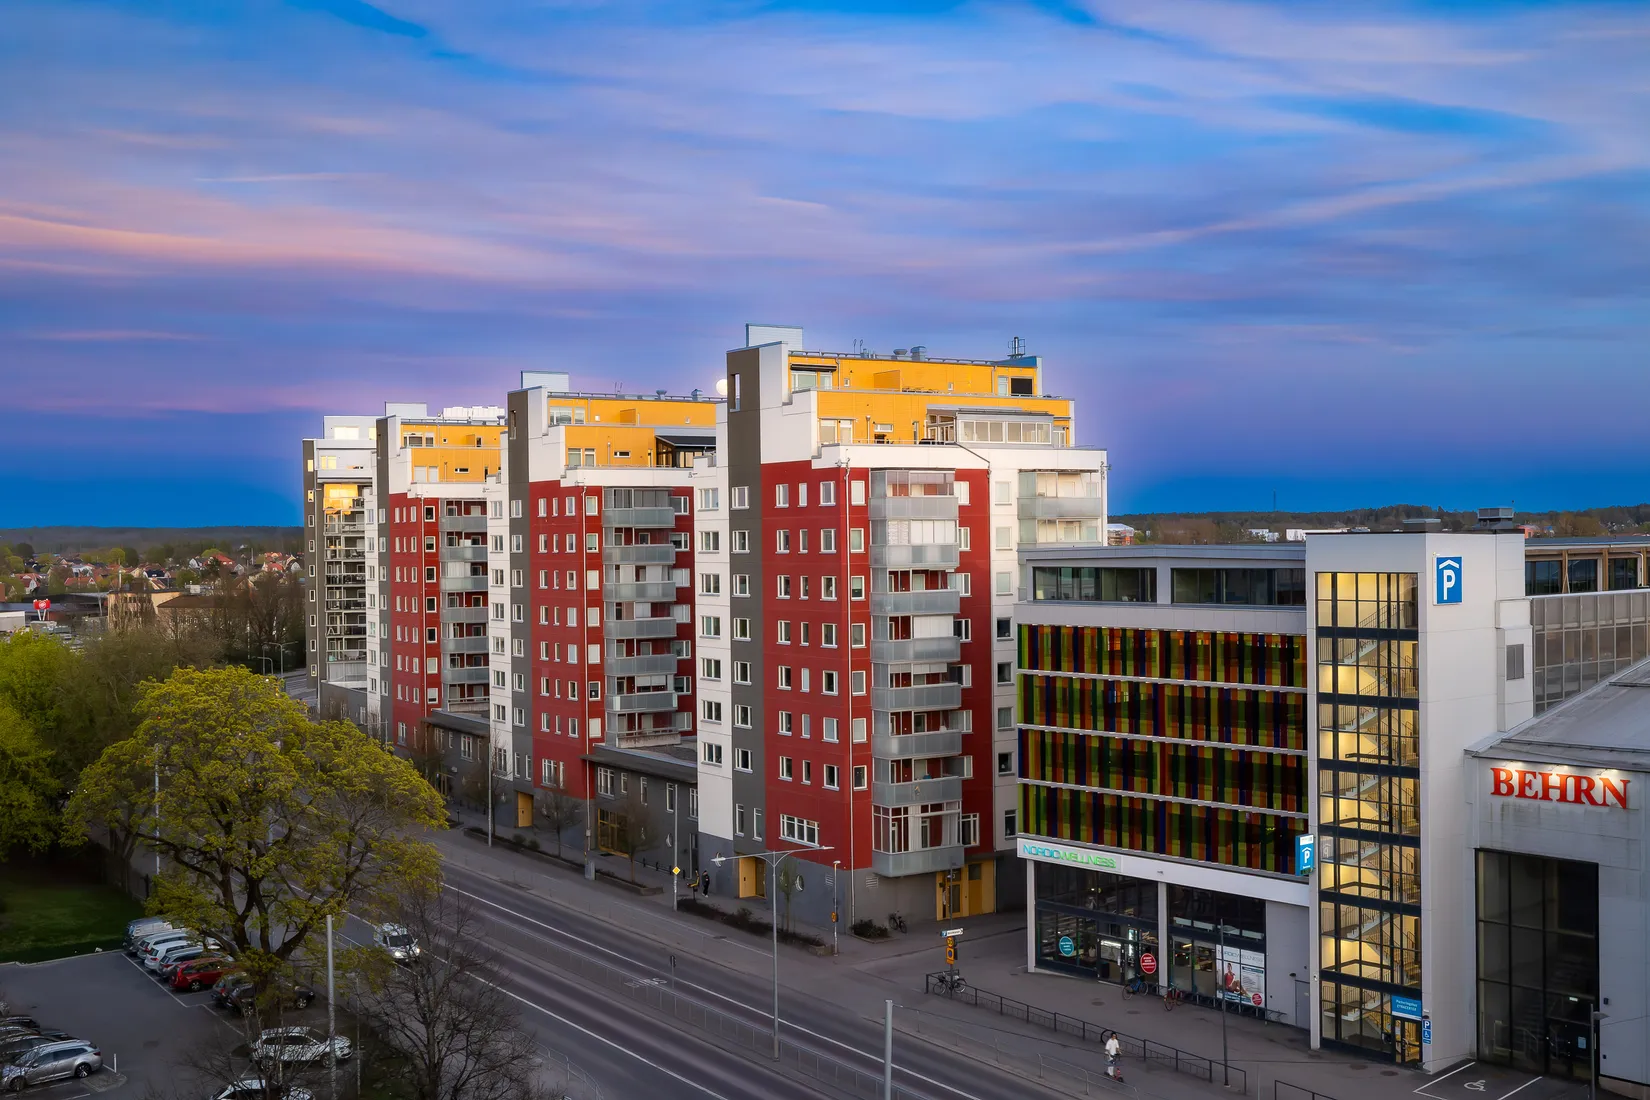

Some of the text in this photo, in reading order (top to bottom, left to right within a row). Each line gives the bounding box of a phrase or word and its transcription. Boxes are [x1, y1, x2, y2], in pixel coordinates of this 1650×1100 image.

[1443, 569, 1456, 600] P
[1490, 767, 1631, 809] BEHRN
[1304, 851, 1310, 863] P
